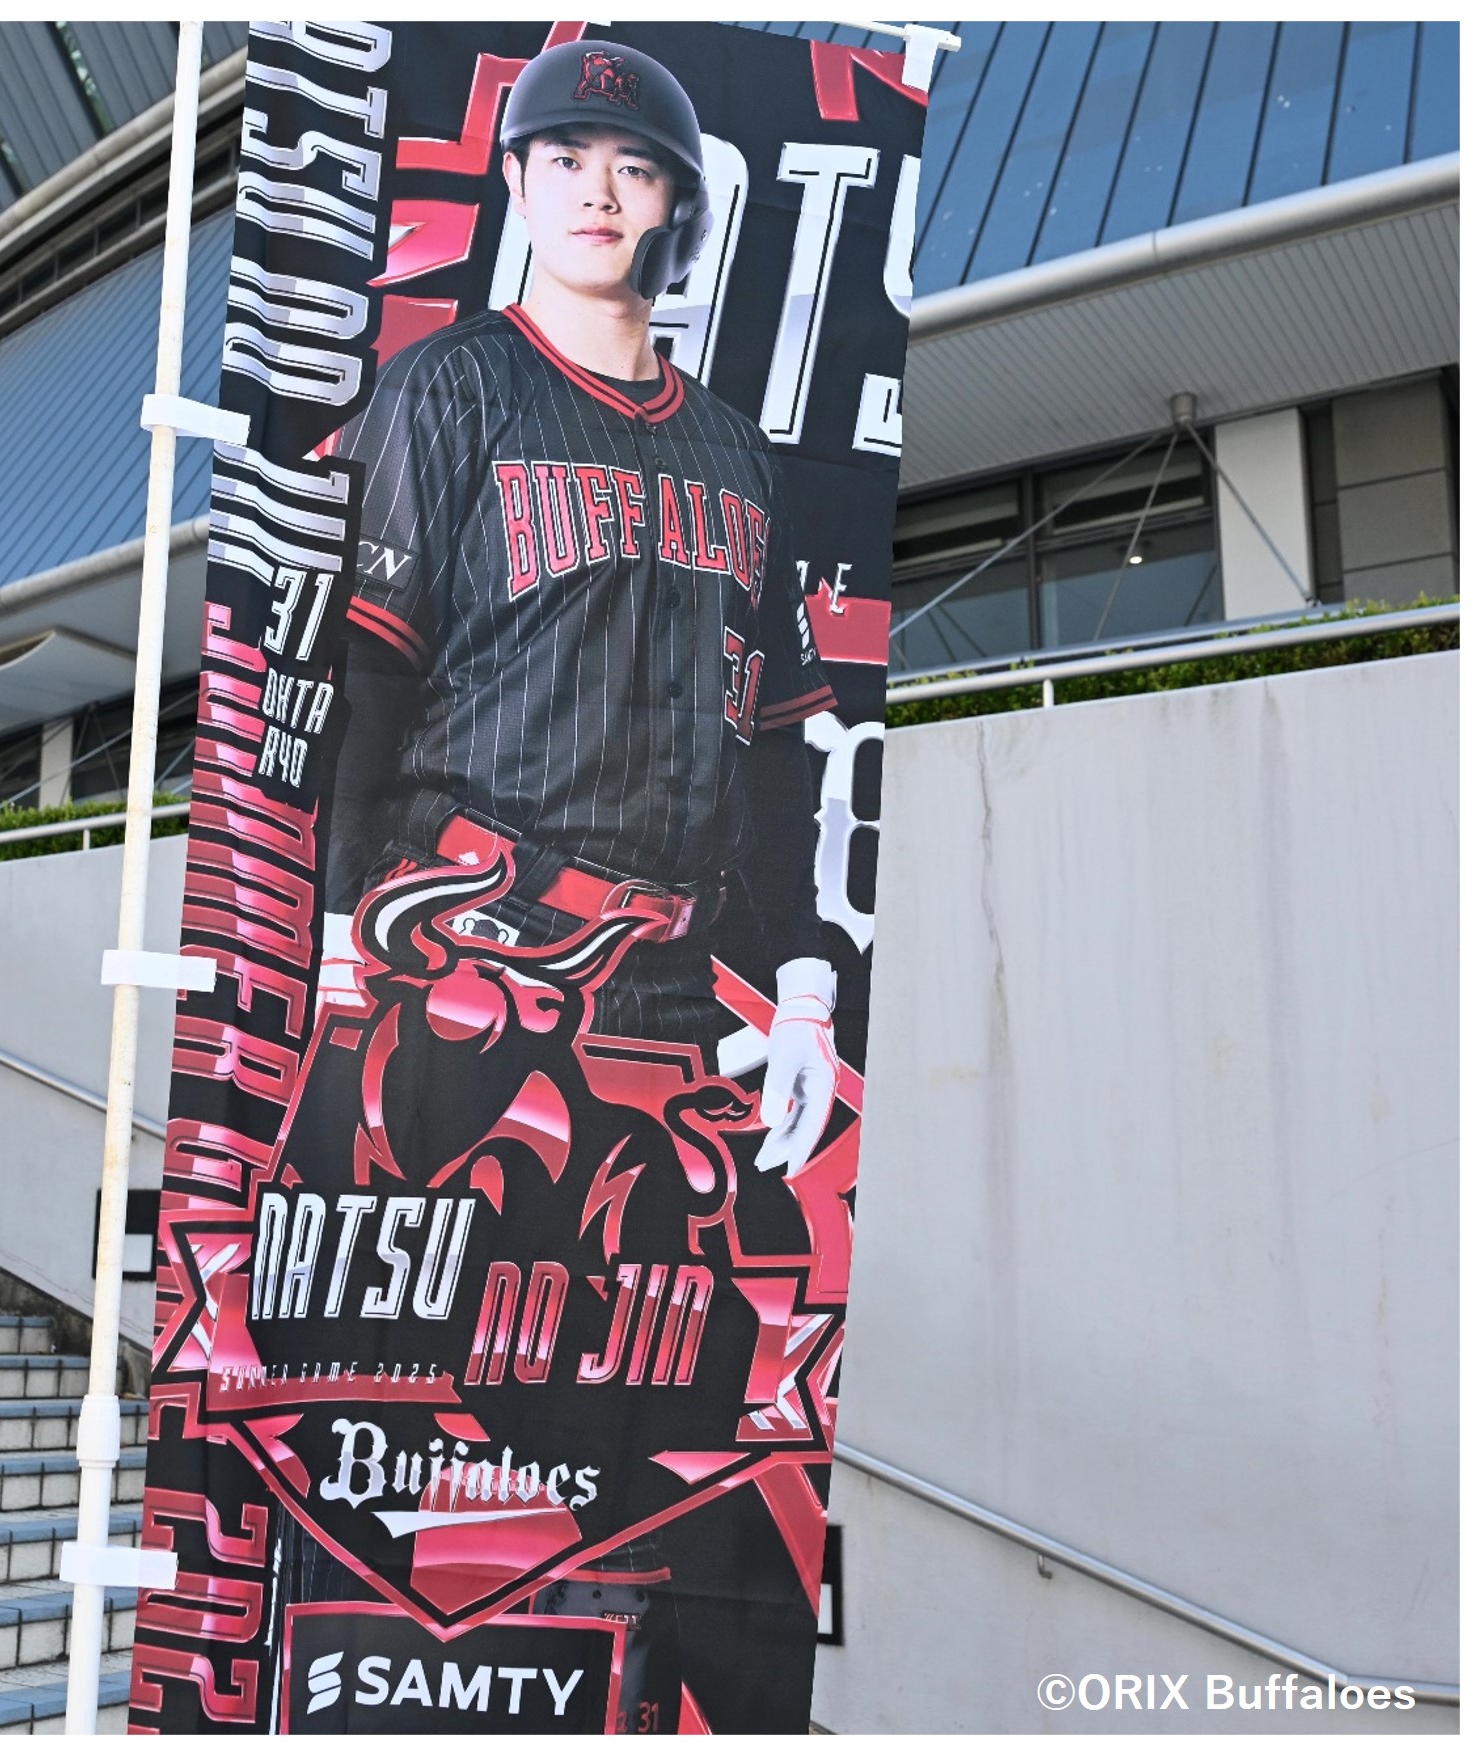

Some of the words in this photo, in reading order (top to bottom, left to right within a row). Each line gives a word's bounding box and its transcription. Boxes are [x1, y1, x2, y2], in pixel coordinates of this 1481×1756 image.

[263, 562, 335, 664] 31
[262, 667, 335, 736] OHTA
[723, 625, 763, 746] 31
[256, 727, 308, 790] RYO
[252, 1192, 476, 1322] NATSU
[464, 1261, 572, 1386] NO
[576, 1264, 713, 1387] JIN
[218, 1364, 289, 1393] SUMMER
[299, 1361, 358, 1383] GAME
[373, 1361, 437, 1384] 2025
[354, 1655, 584, 1717] SAMTY
[638, 1701, 660, 1733] 31
